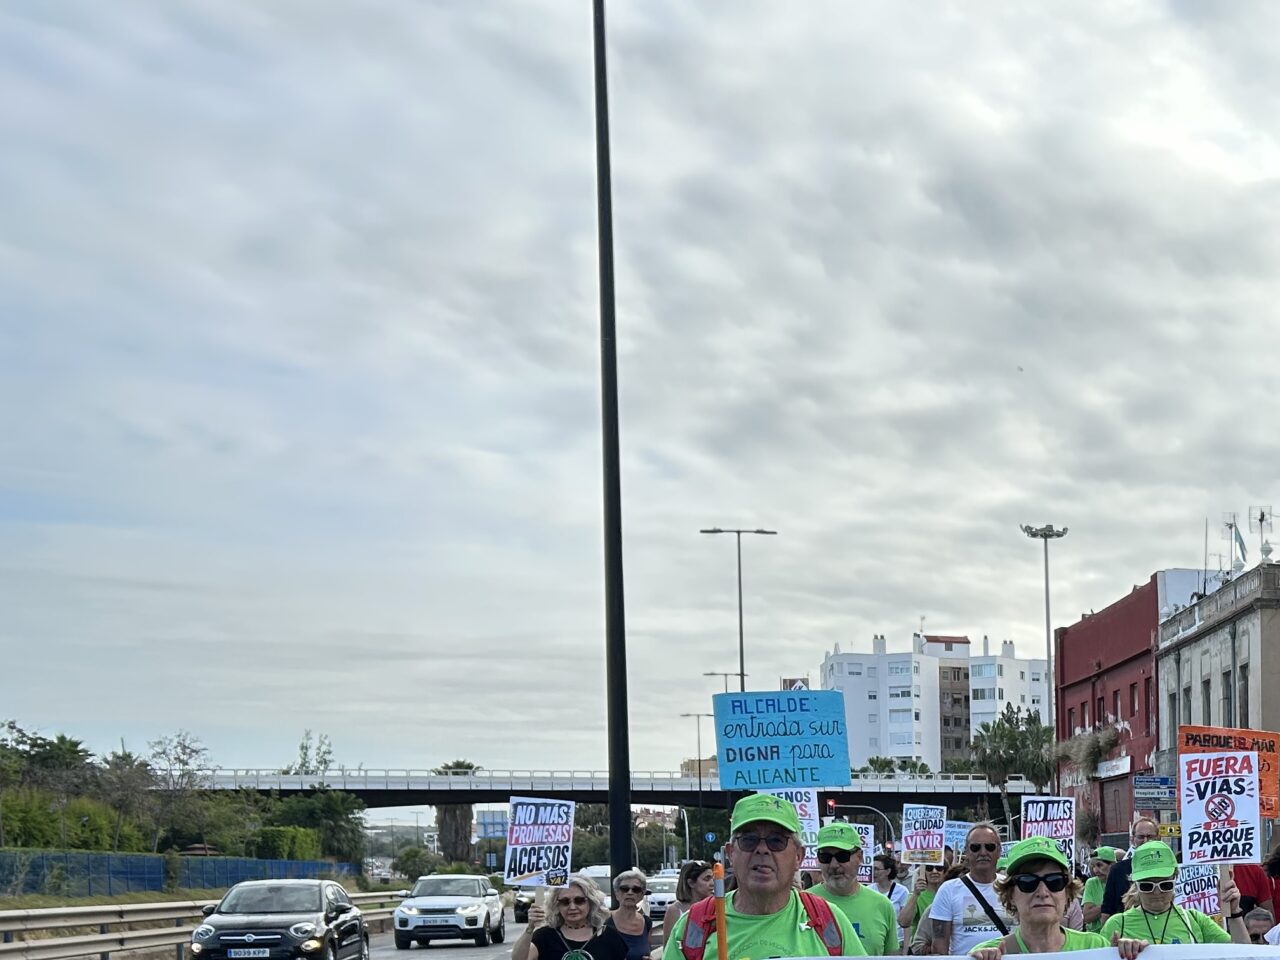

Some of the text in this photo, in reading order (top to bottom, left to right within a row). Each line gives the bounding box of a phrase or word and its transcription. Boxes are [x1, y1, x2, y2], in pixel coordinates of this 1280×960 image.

[731, 697, 818, 715] ALCALDE:
[723, 715, 844, 739] entrada sur
[1184, 732, 1233, 749] PARQUE
[1250, 738, 1276, 753] MAR
[725, 743, 835, 767] DIGNA para
[734, 767, 821, 786] ALICANTE
[1185, 755, 1254, 781] FUERA
[1194, 776, 1246, 801] VÍAS
[514, 803, 568, 825] NO MÁS
[907, 808, 942, 820] QUEREMOS
[1027, 800, 1071, 822] NO MÁS
[511, 824, 570, 844] PROMESAS
[913, 819, 944, 831] CIUDAD
[1025, 819, 1073, 840] PROMESAS
[1210, 820, 1231, 830] DEL
[906, 834, 942, 849] VIVIR
[1187, 826, 1255, 850] PARQUE
[1190, 842, 1254, 860] DEL MAR
[506, 845, 570, 880] ACCESOS
[1183, 875, 1219, 896] CIUDAD
